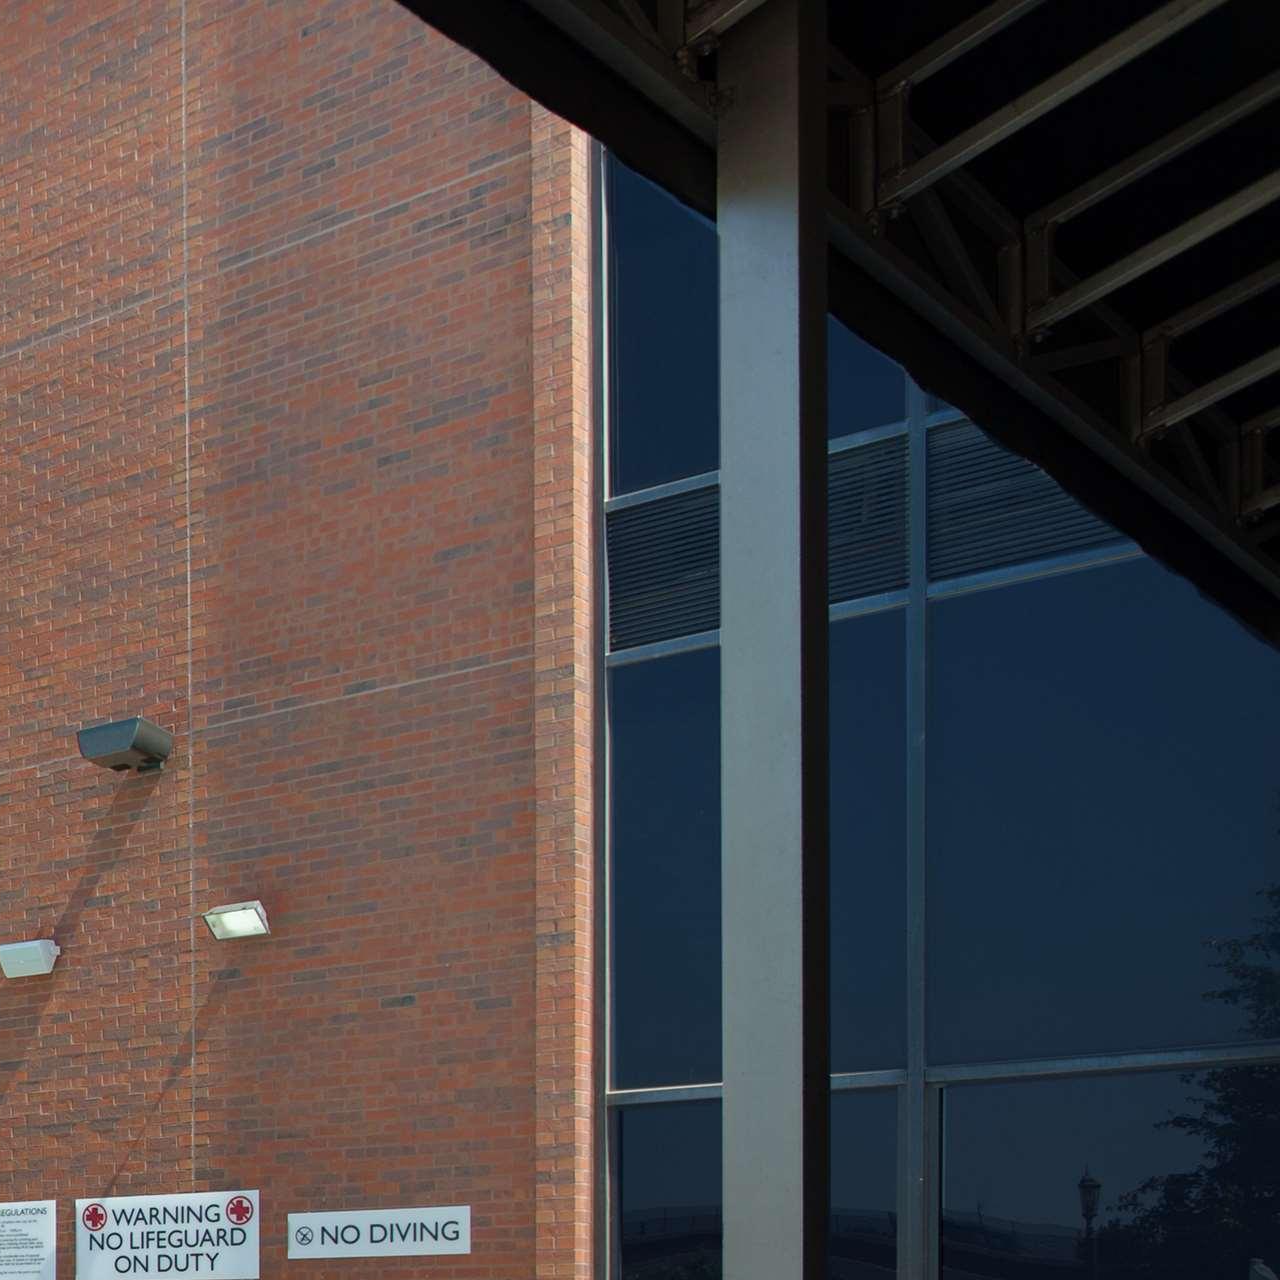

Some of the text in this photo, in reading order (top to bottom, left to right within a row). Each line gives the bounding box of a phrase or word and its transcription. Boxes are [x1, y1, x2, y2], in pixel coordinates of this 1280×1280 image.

[112, 1204, 221, 1226] WARNING
[89, 1227, 247, 1251] NO LIFEGUARD
[320, 1220, 460, 1245] NO DIVING
[114, 1252, 220, 1273] ON DUTY
